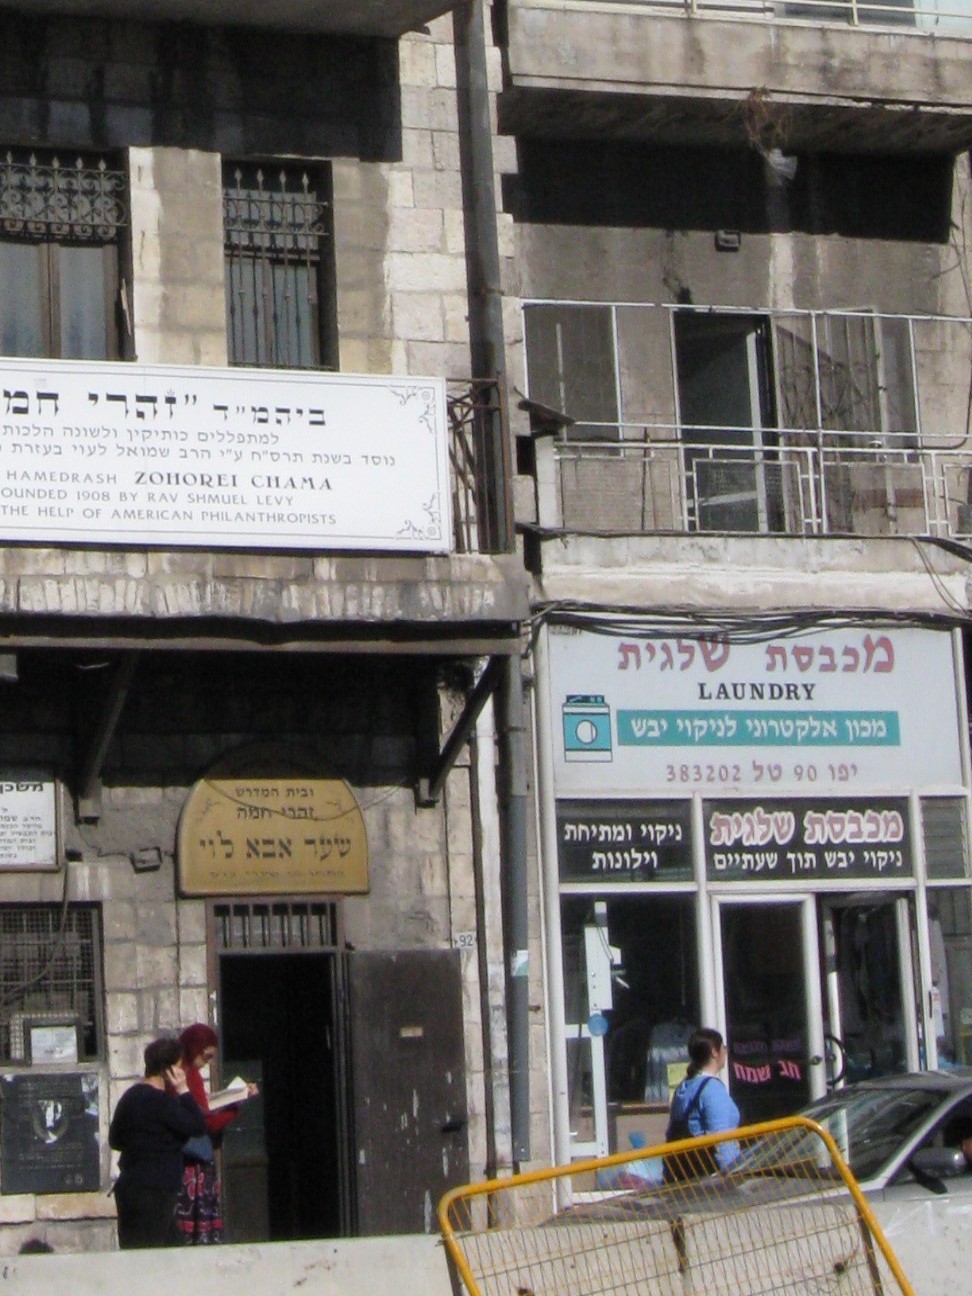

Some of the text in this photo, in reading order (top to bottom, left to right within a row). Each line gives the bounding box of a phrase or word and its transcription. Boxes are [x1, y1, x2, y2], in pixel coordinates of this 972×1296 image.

[3, 423, 278, 445] למתפללים כותיקין ולשונה הלכות
[12, 442, 62, 457] בעזרת
[72, 444, 106, 457] לעוי
[116, 443, 169, 458] שמואל
[179, 448, 210, 459] הרב
[219, 448, 242, 462] ע"י
[251, 450, 304, 463] תרס"ח
[312, 453, 352, 465] בשנת
[362, 455, 395, 467] נוסד
[7, 469, 116, 484] HAMEDRASH
[135, 472, 237, 489] ZOHOREI
[251, 476, 333, 491] CHAMA
[78, 490, 110, 501] 1908
[119, 492, 138, 502] BY
[148, 492, 177, 503] RAV
[188, 493, 247, 505] SHMUEL
[256, 495, 293, 506] LEVY
[0, 504, 29, 516] THE
[38, 506, 74, 518] HELP
[83, 507, 101, 519] OF
[111, 508, 192, 521] AMERICAN
[201, 511, 337, 525] PHILANTHROPISTS
[617, 633, 895, 673] מכבסת שלגית
[698, 683, 816, 701] LAUNDRY
[630, 715, 887, 742] מכון אלקטרוני לניקוי יבש
[666, 759, 859, 783] יפו 90 טל 383202
[0, 782, 43, 793] משכן
[235, 787, 278, 798] המדרש
[563, 823, 683, 846] ניקוי ומתיחת
[709, 805, 903, 846] מכבסת שלגית
[591, 848, 658, 870] וילונות
[713, 850, 903, 874] ניקוי יבש תוך שעתיים
[733, 1060, 802, 1084] חג שמח
